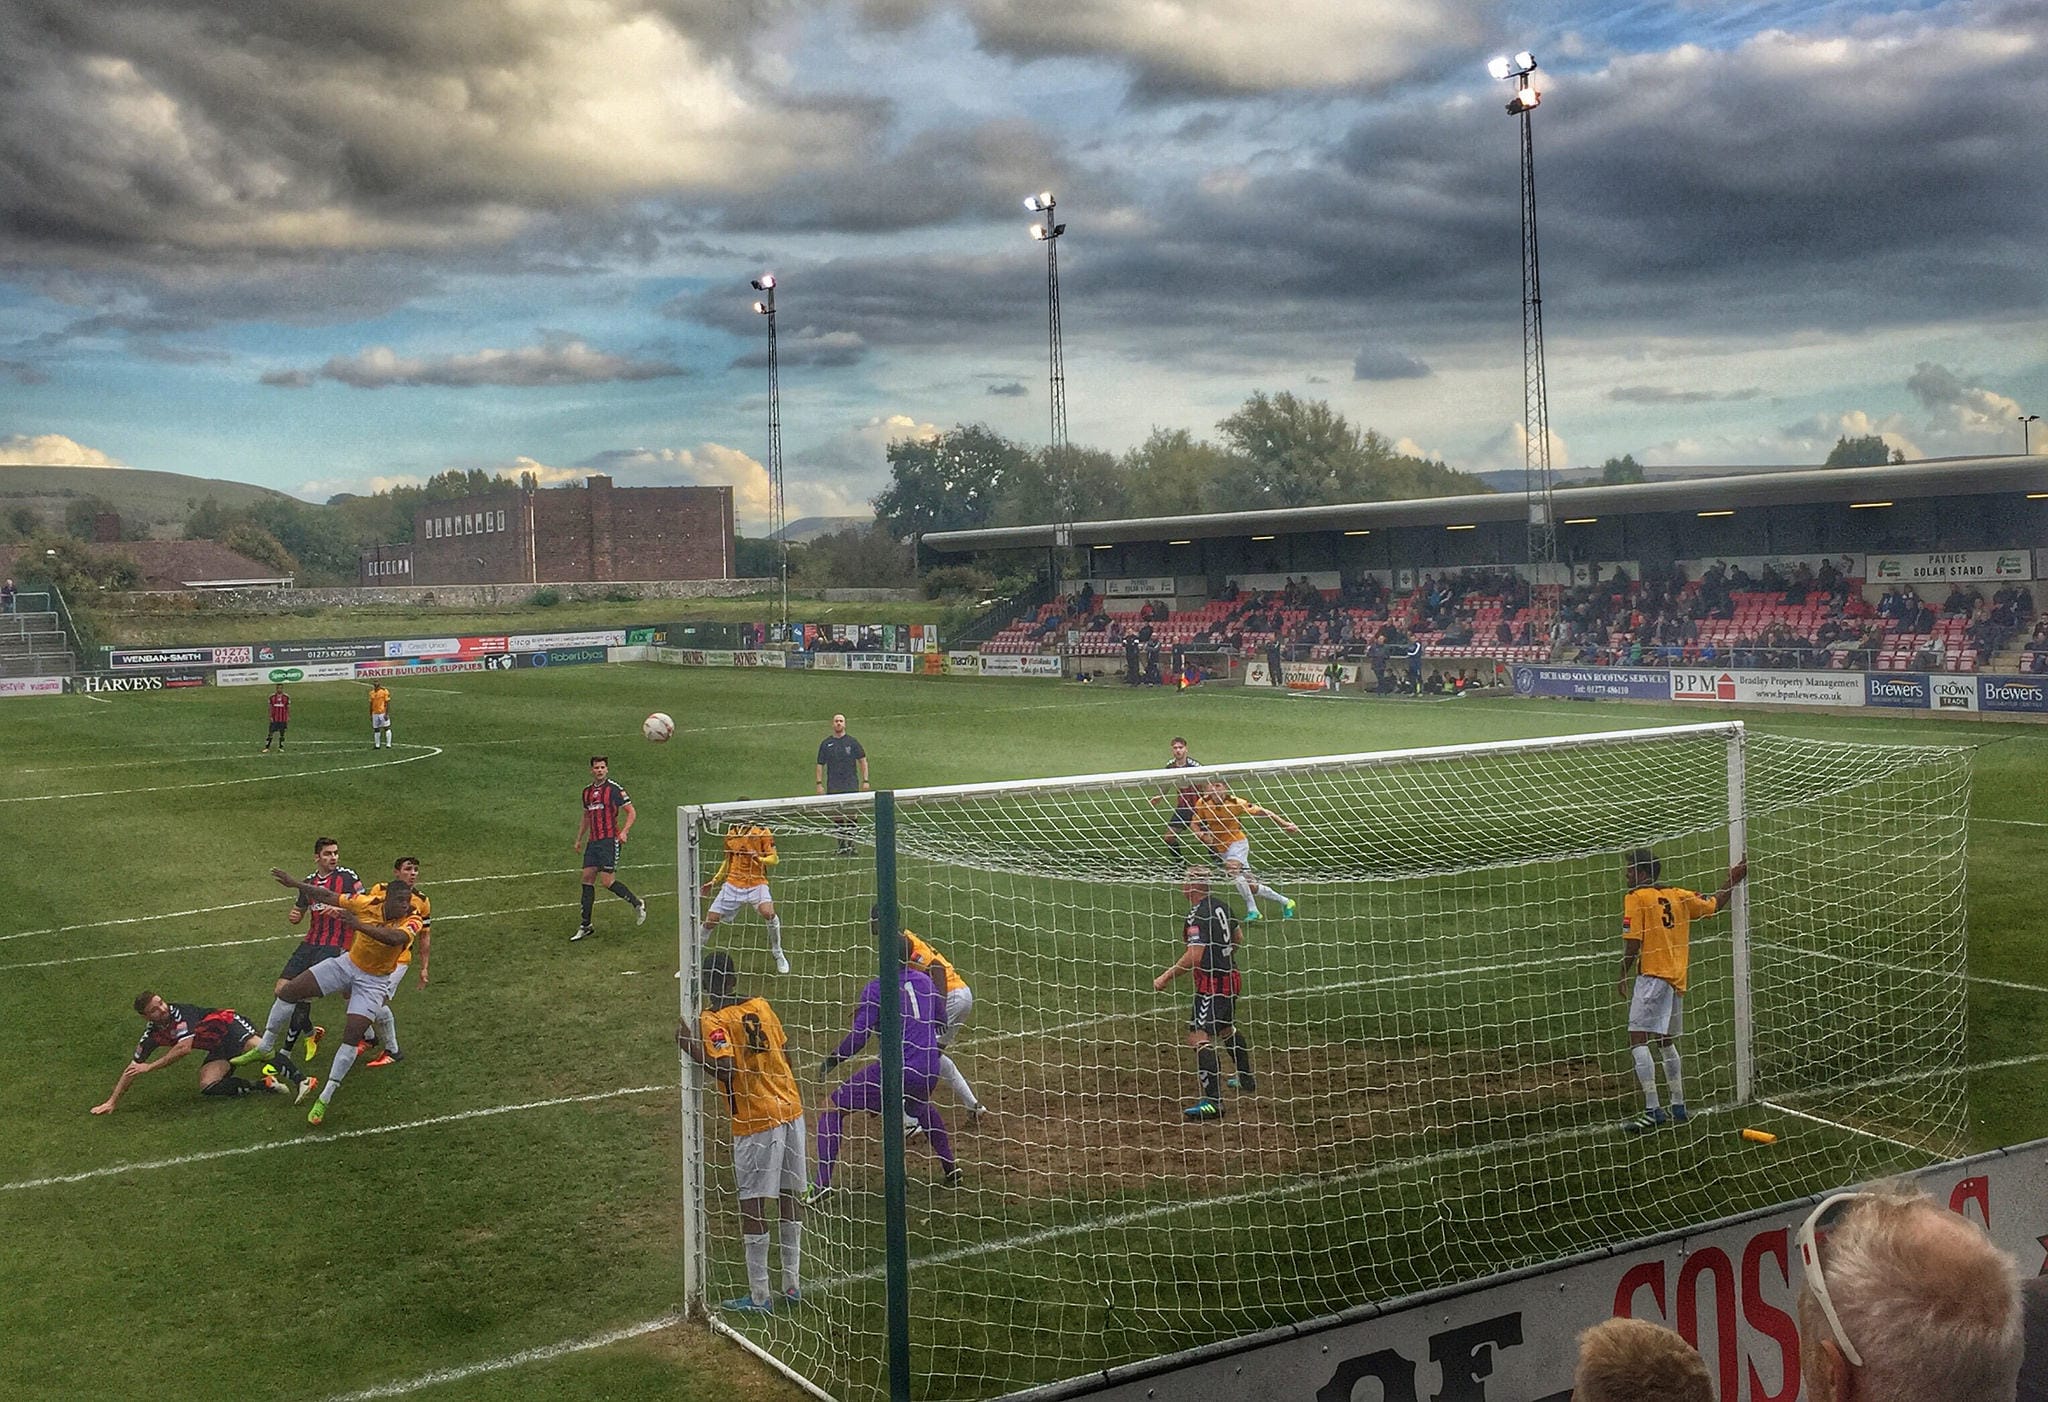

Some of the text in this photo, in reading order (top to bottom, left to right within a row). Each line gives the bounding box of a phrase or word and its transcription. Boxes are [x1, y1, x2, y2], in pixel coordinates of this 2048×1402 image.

[1928, 554, 1967, 565] PAYNES
[1913, 566, 1946, 577] SOLAR
[1950, 565, 1984, 577] STAND
[215, 647, 250, 656] 01273
[307, 651, 330, 659] 01273
[551, 650, 604, 662] Robert Dyas
[122, 653, 201, 664] WENBAN-SMITH
[215, 655, 251, 664] 472495
[683, 651, 704, 665] PAYNES
[733, 652, 758, 666] PAYNES
[356, 668, 393, 678] PARKER
[395, 665, 434, 676] BUILDING
[439, 663, 483, 673] SUPPLIES
[1540, 671, 1668, 683] RICHARD SOAN ROOFING SERVICES
[1740, 676, 1859, 689] Bradley Property Management
[84, 676, 162, 692] HARVEYS
[1587, 685, 1605, 694] 01273
[1674, 675, 1716, 692] BPM
[1871, 680, 1924, 697] Brewers
[1933, 683, 1975, 696] CROWN
[1755, 689, 1842, 701] www.bpmlewes.co.uk
[1985, 683, 2044, 701] Brewers
[1942, 698, 1965, 706] TRADE
[1657, 897, 1675, 930] 3
[1215, 906, 1231, 944] 9
